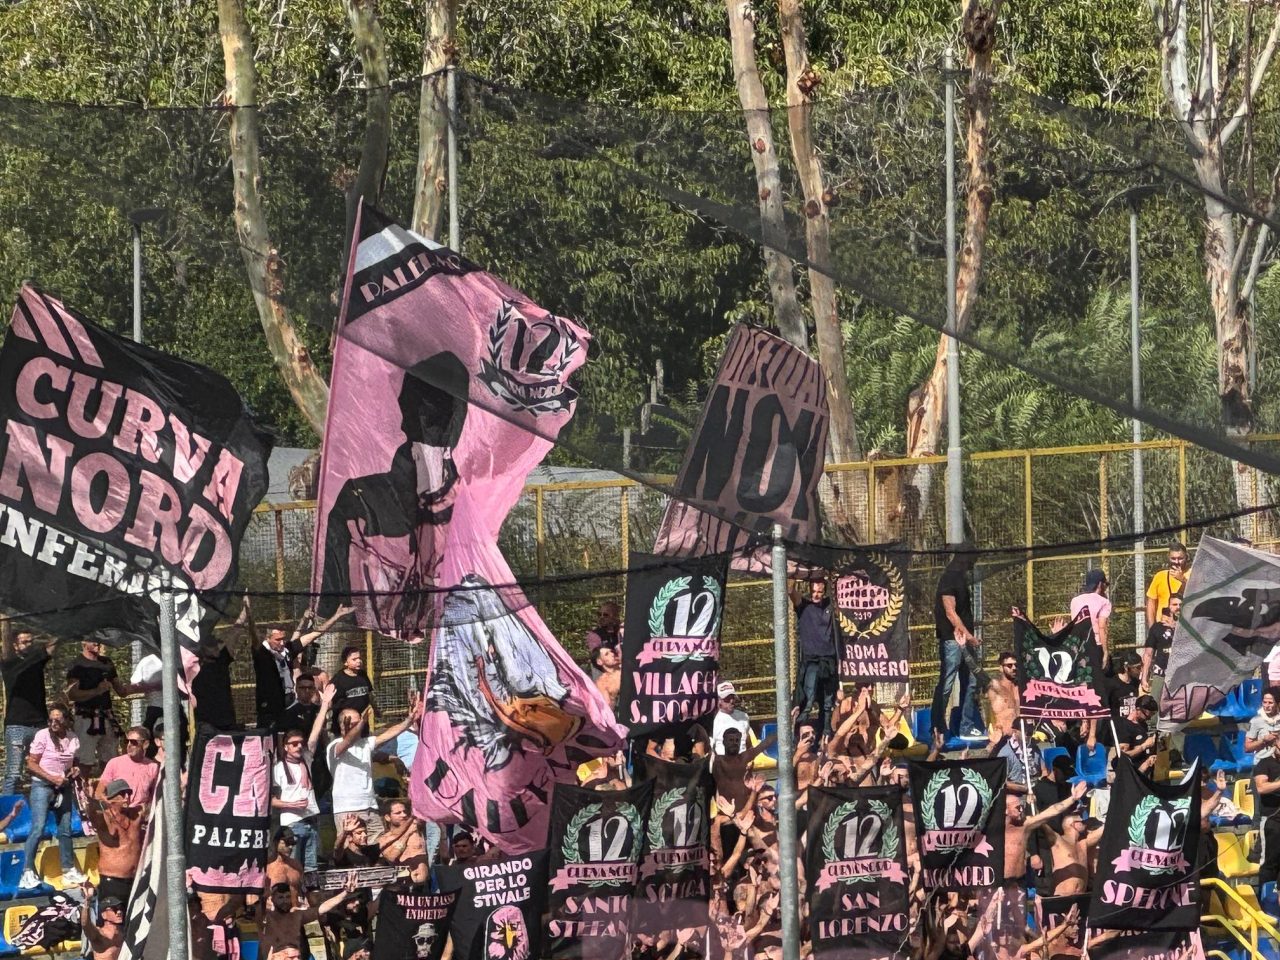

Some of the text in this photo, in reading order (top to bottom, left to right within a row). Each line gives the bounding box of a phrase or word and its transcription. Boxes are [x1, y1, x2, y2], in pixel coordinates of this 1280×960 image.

[15, 356, 245, 525] CURVA
[0, 418, 233, 590] NORD
[673, 591, 715, 636] 12
[845, 643, 889, 660] ROMA
[838, 659, 909, 677] OSANERO
[629, 699, 648, 724] S.
[940, 783, 978, 829] 12
[191, 824, 271, 850] PALER
[670, 803, 702, 848] 12
[842, 814, 882, 859] 12
[586, 815, 629, 862] 12
[463, 857, 533, 881] GIRANDO
[954, 865, 996, 886] NORD
[475, 873, 528, 893] PER LO
[397, 894, 415, 906] MAI
[416, 895, 432, 906] UN
[473, 886, 531, 908] STIVALE
[841, 890, 881, 912] SAN
[818, 912, 910, 940] LORENZO
